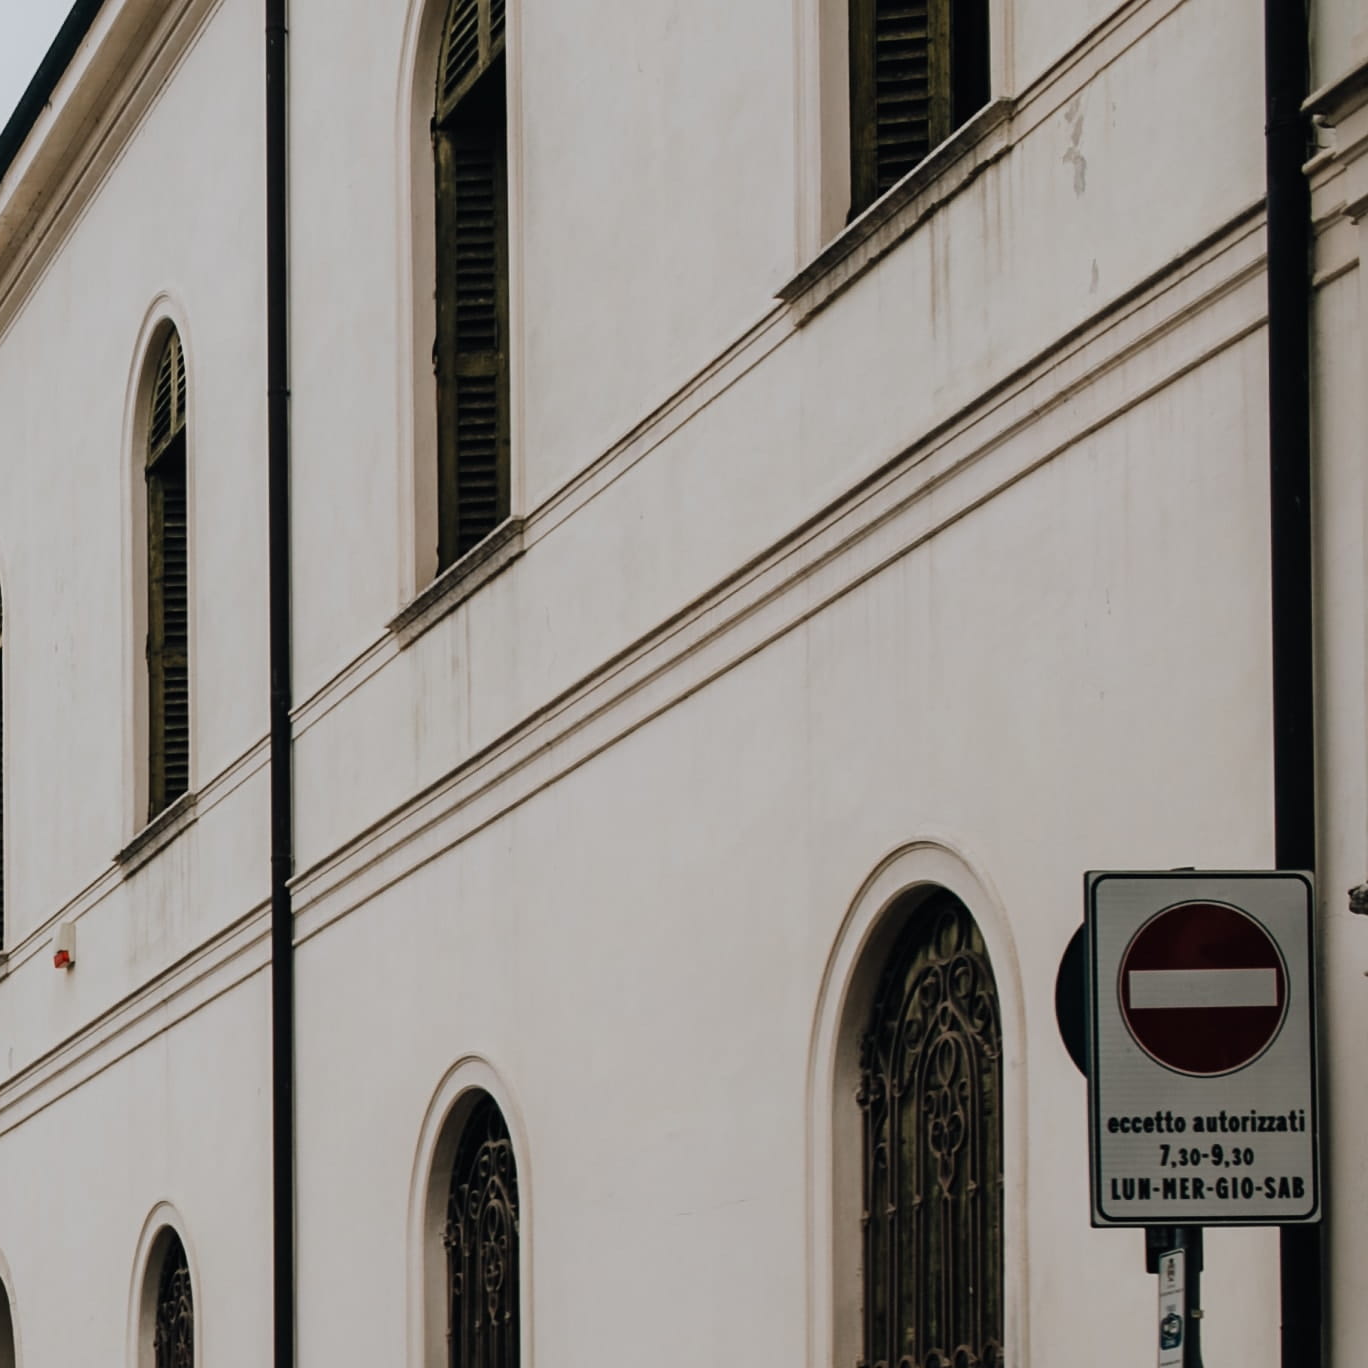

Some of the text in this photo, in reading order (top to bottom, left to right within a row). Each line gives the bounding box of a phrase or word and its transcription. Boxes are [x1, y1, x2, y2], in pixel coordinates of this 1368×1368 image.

[1107, 1109, 1305, 1133] eccetto autorizzati
[1159, 1144, 1254, 1168] 7,30-9,30
[1111, 1177, 1305, 1200] LUN-MER-GIO-SAB
